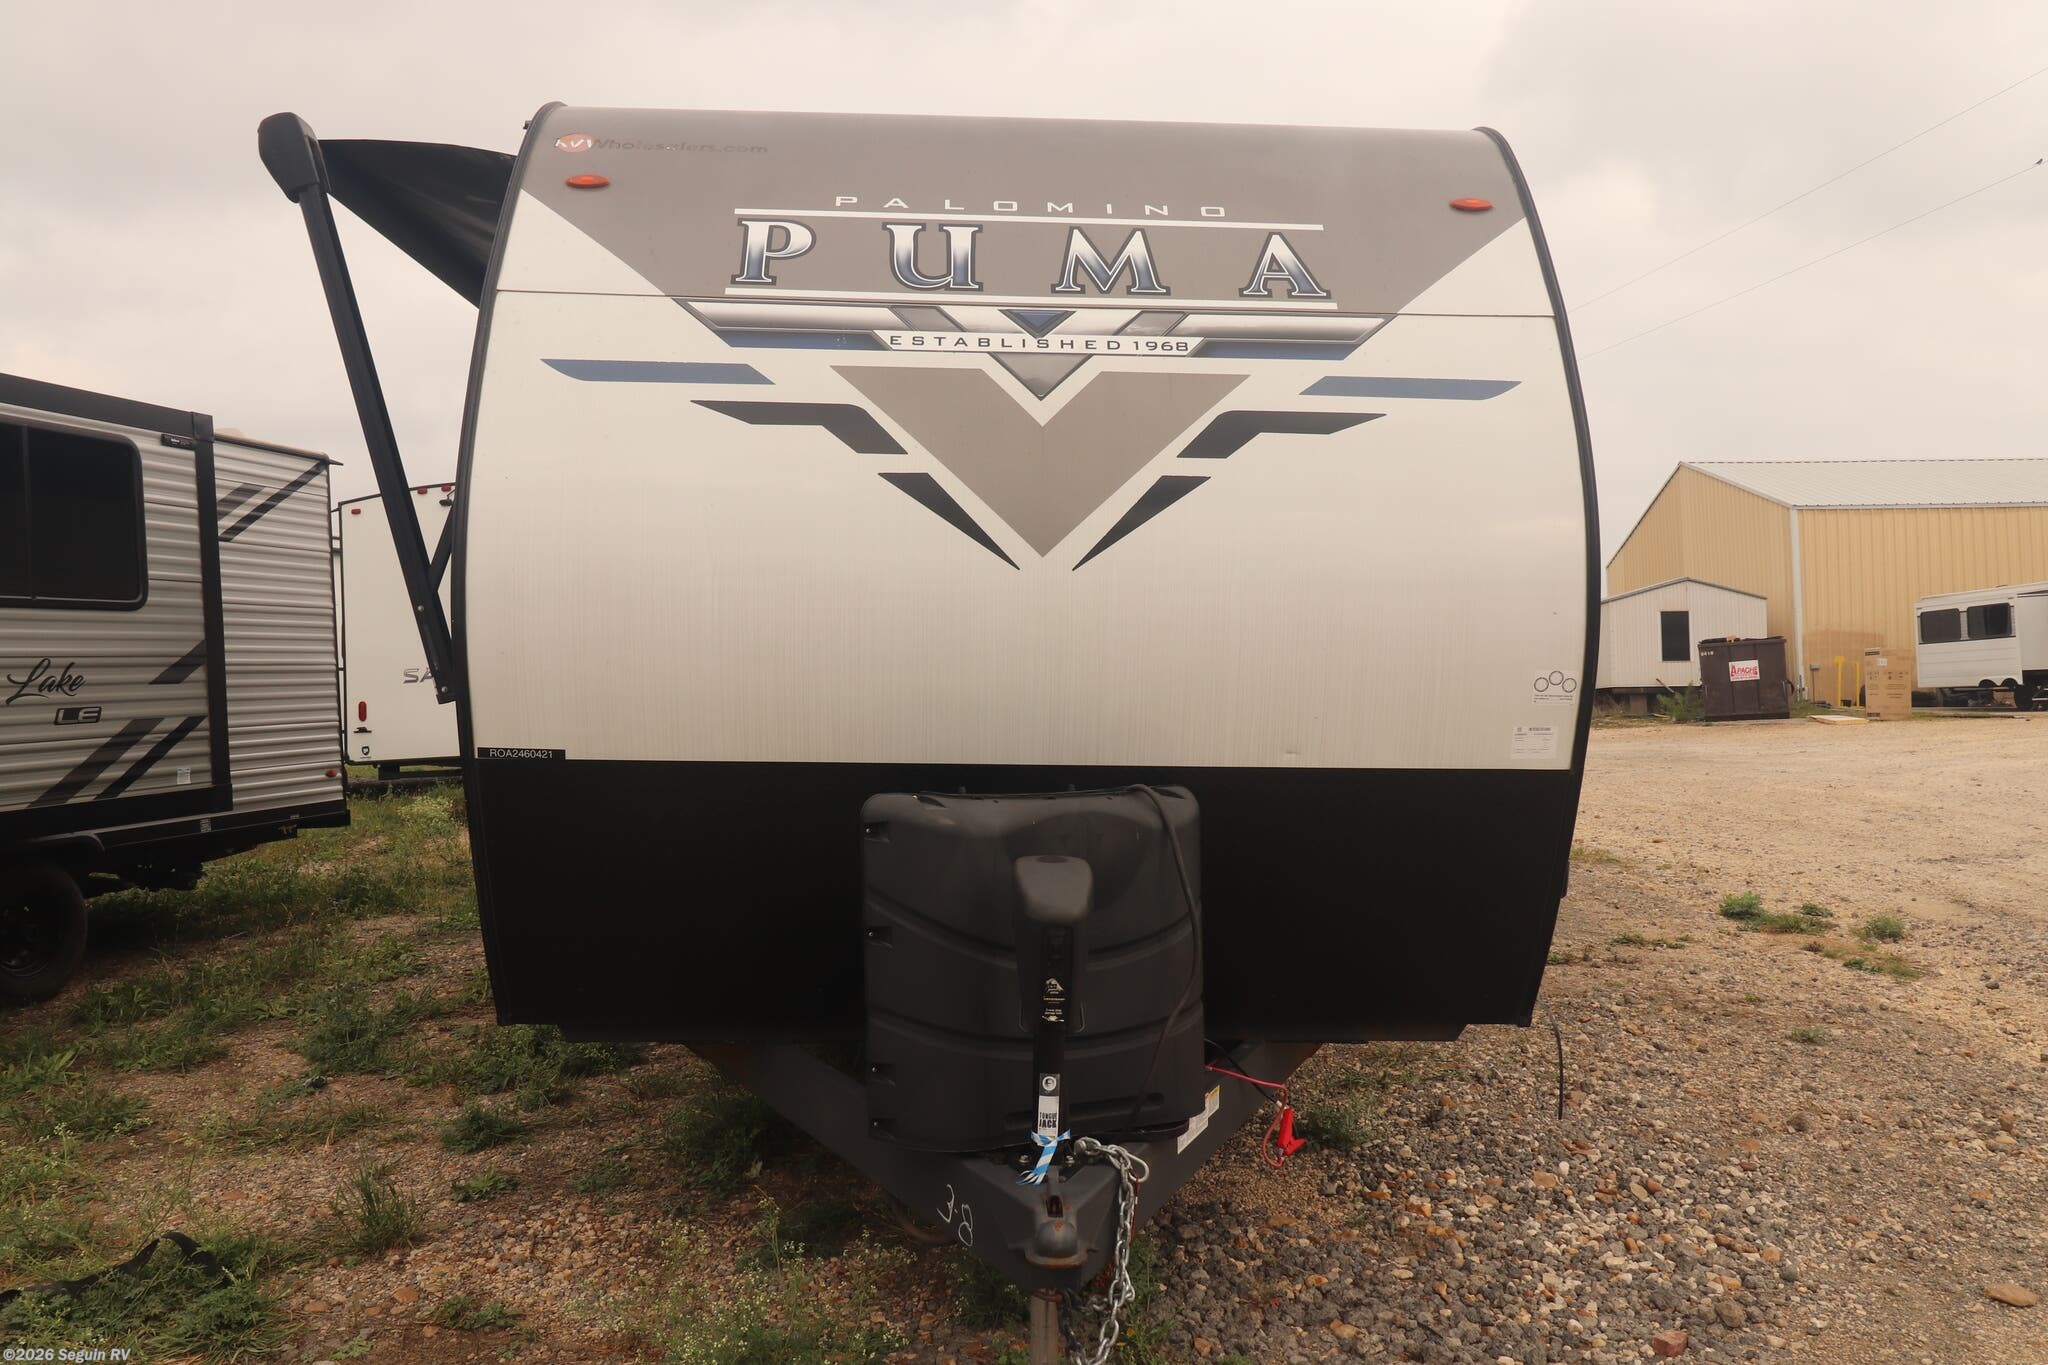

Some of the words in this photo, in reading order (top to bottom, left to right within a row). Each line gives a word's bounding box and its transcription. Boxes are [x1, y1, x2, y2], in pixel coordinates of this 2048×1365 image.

[835, 196, 1225, 217] PALOMINO
[731, 217, 1331, 299] PUMA
[890, 335, 1121, 351] ESTABLISHED
[1133, 340, 1189, 351] 1968
[1731, 665, 1758, 676] APACHE
[6, 658, 86, 705] Lake
[58, 709, 99, 722] LE
[489, 749, 553, 758] ROA2460421
[1039, 1119, 1056, 1128] JACK
